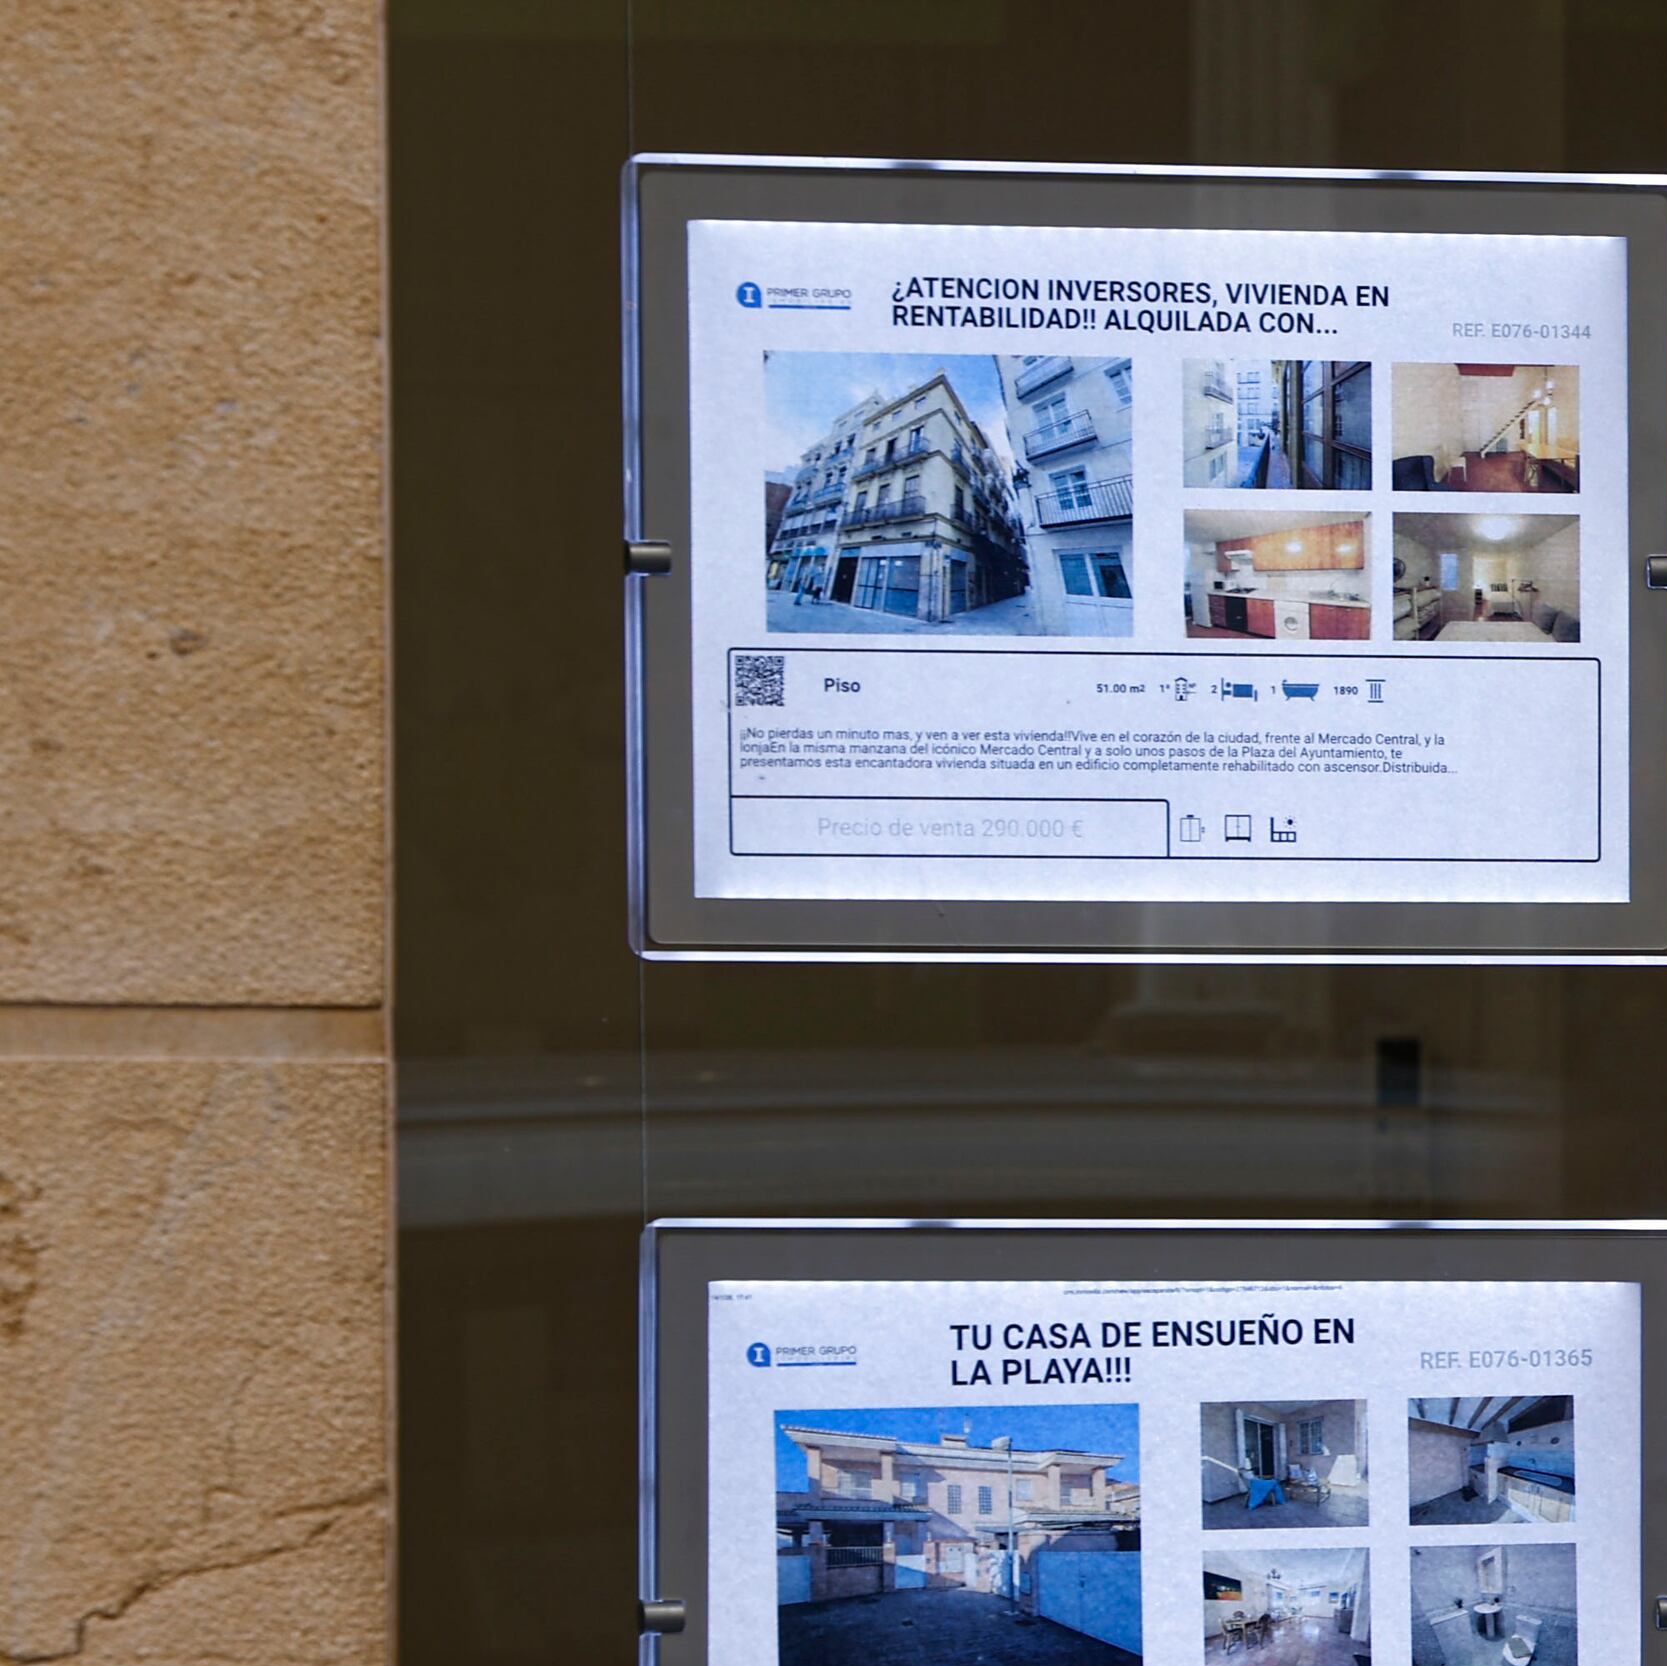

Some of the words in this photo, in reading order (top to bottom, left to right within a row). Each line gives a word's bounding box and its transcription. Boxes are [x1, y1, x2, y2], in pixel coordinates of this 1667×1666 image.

[892, 276, 1039, 310] ¿ATENCION
[1048, 279, 1217, 310] INVERSORES,
[1225, 282, 1349, 307] VIVIENDA
[1356, 285, 1389, 307] EN
[892, 308, 1096, 330] RENTABILIDAD!!
[1104, 309, 1252, 334] ALQUILADA
[1259, 311, 1338, 335] CON...
[1453, 322, 1487, 338] REF.
[1491, 323, 1592, 340] E076-01344
[824, 677, 861, 693] Piso
[818, 818, 881, 837] Precio
[888, 818, 913, 837] de
[920, 820, 975, 837] venta
[982, 819, 1064, 838] 290.000
[1071, 820, 1083, 838] €
[949, 1324, 992, 1351] TU
[1003, 1322, 1092, 1350] CASA
[1101, 1321, 1142, 1348] DE
[1152, 1313, 1303, 1348] ENSUEÑO
[1314, 1317, 1355, 1345] EN
[1420, 1351, 1463, 1369] REF.
[1469, 1348, 1593, 1369] E076-01365
[951, 1359, 992, 1386] LA
[1002, 1356, 1131, 1385] PLAYA!!!
